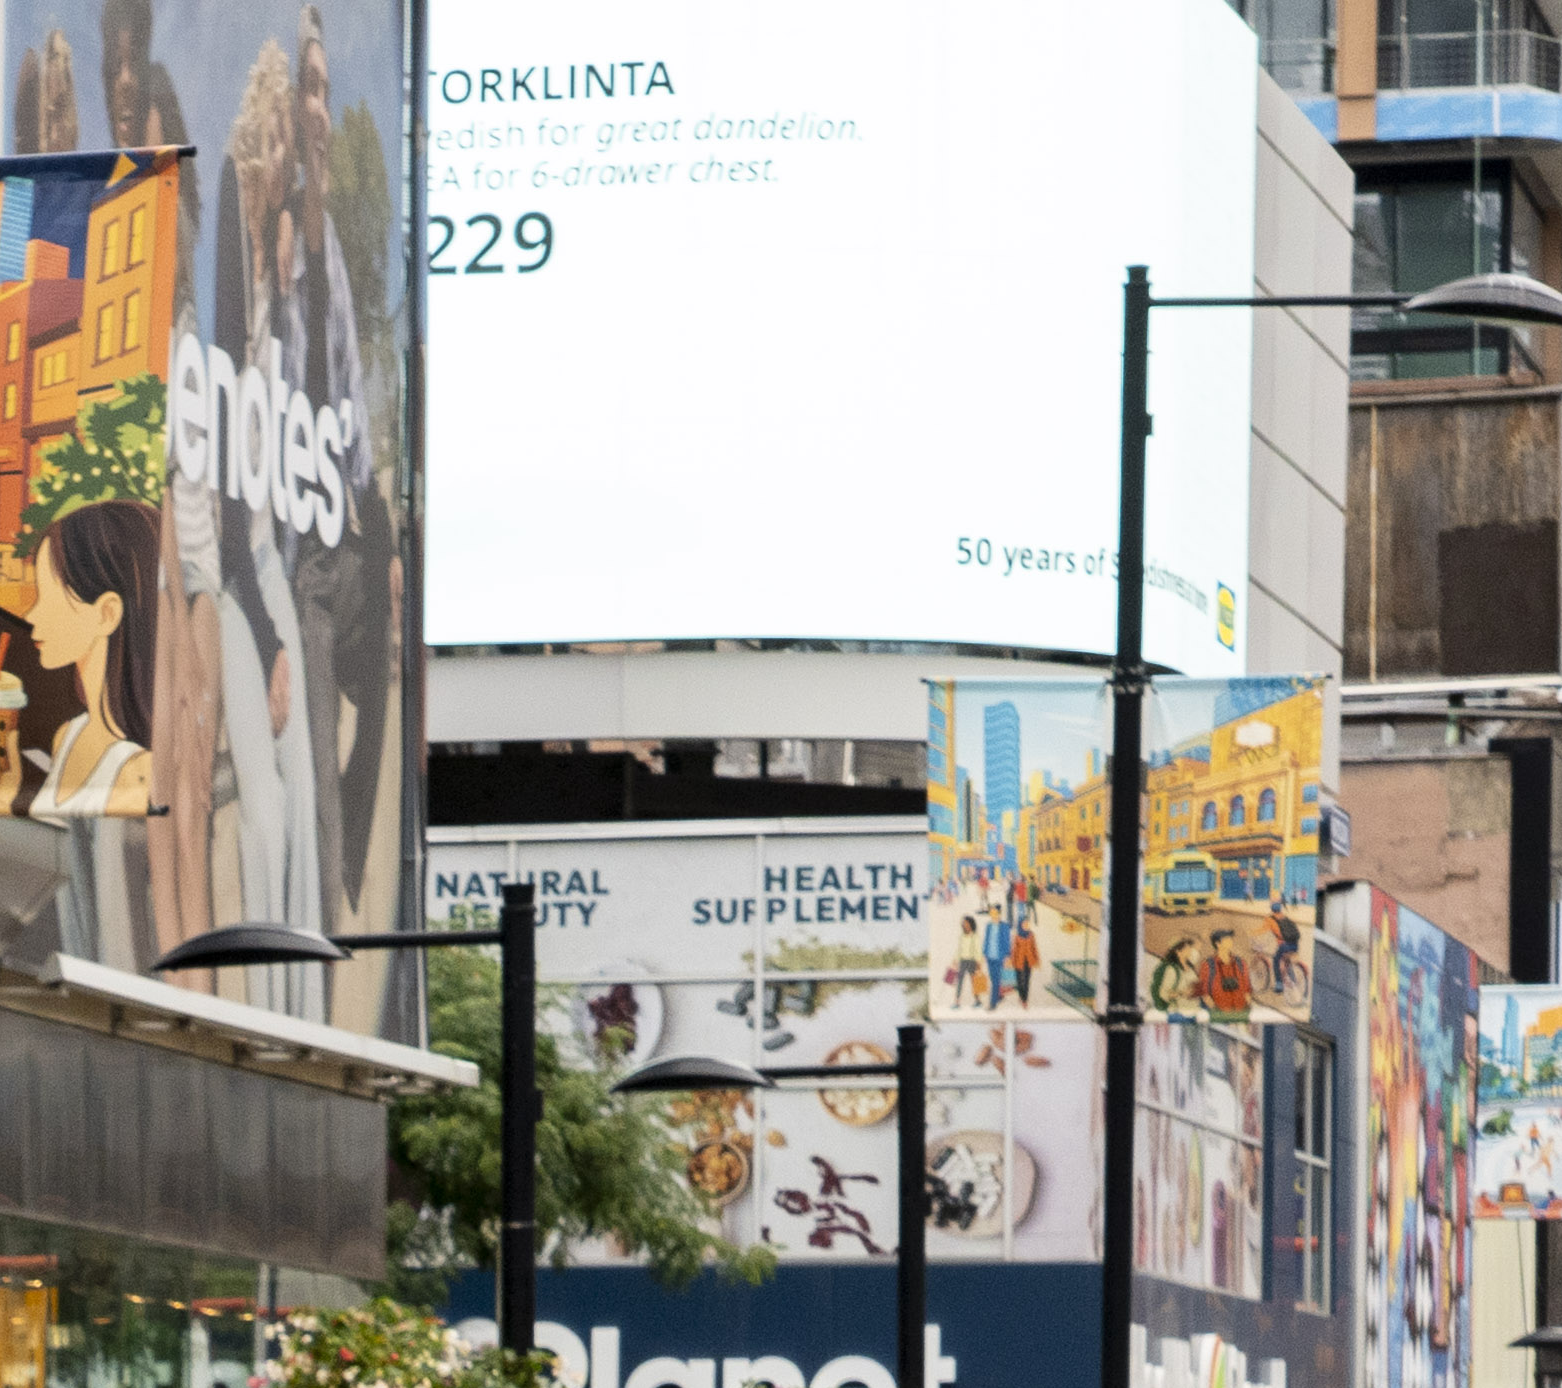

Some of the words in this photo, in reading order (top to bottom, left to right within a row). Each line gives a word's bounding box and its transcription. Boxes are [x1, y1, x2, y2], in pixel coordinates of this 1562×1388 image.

[428, 61, 675, 105] ORKLINTA
[538, 116, 585, 147] for
[596, 113, 682, 153] great
[693, 110, 864, 144] dandelion.
[472, 160, 520, 190] for
[531, 158, 678, 189] 6-drawer
[688, 154, 779, 184] chest.
[956, 536, 993, 567] 50
[1003, 544, 1077, 577] years
[1083, 548, 1106, 576] of
[764, 864, 914, 893] HEALTH
[692, 895, 930, 925] SUPPLEMEN
